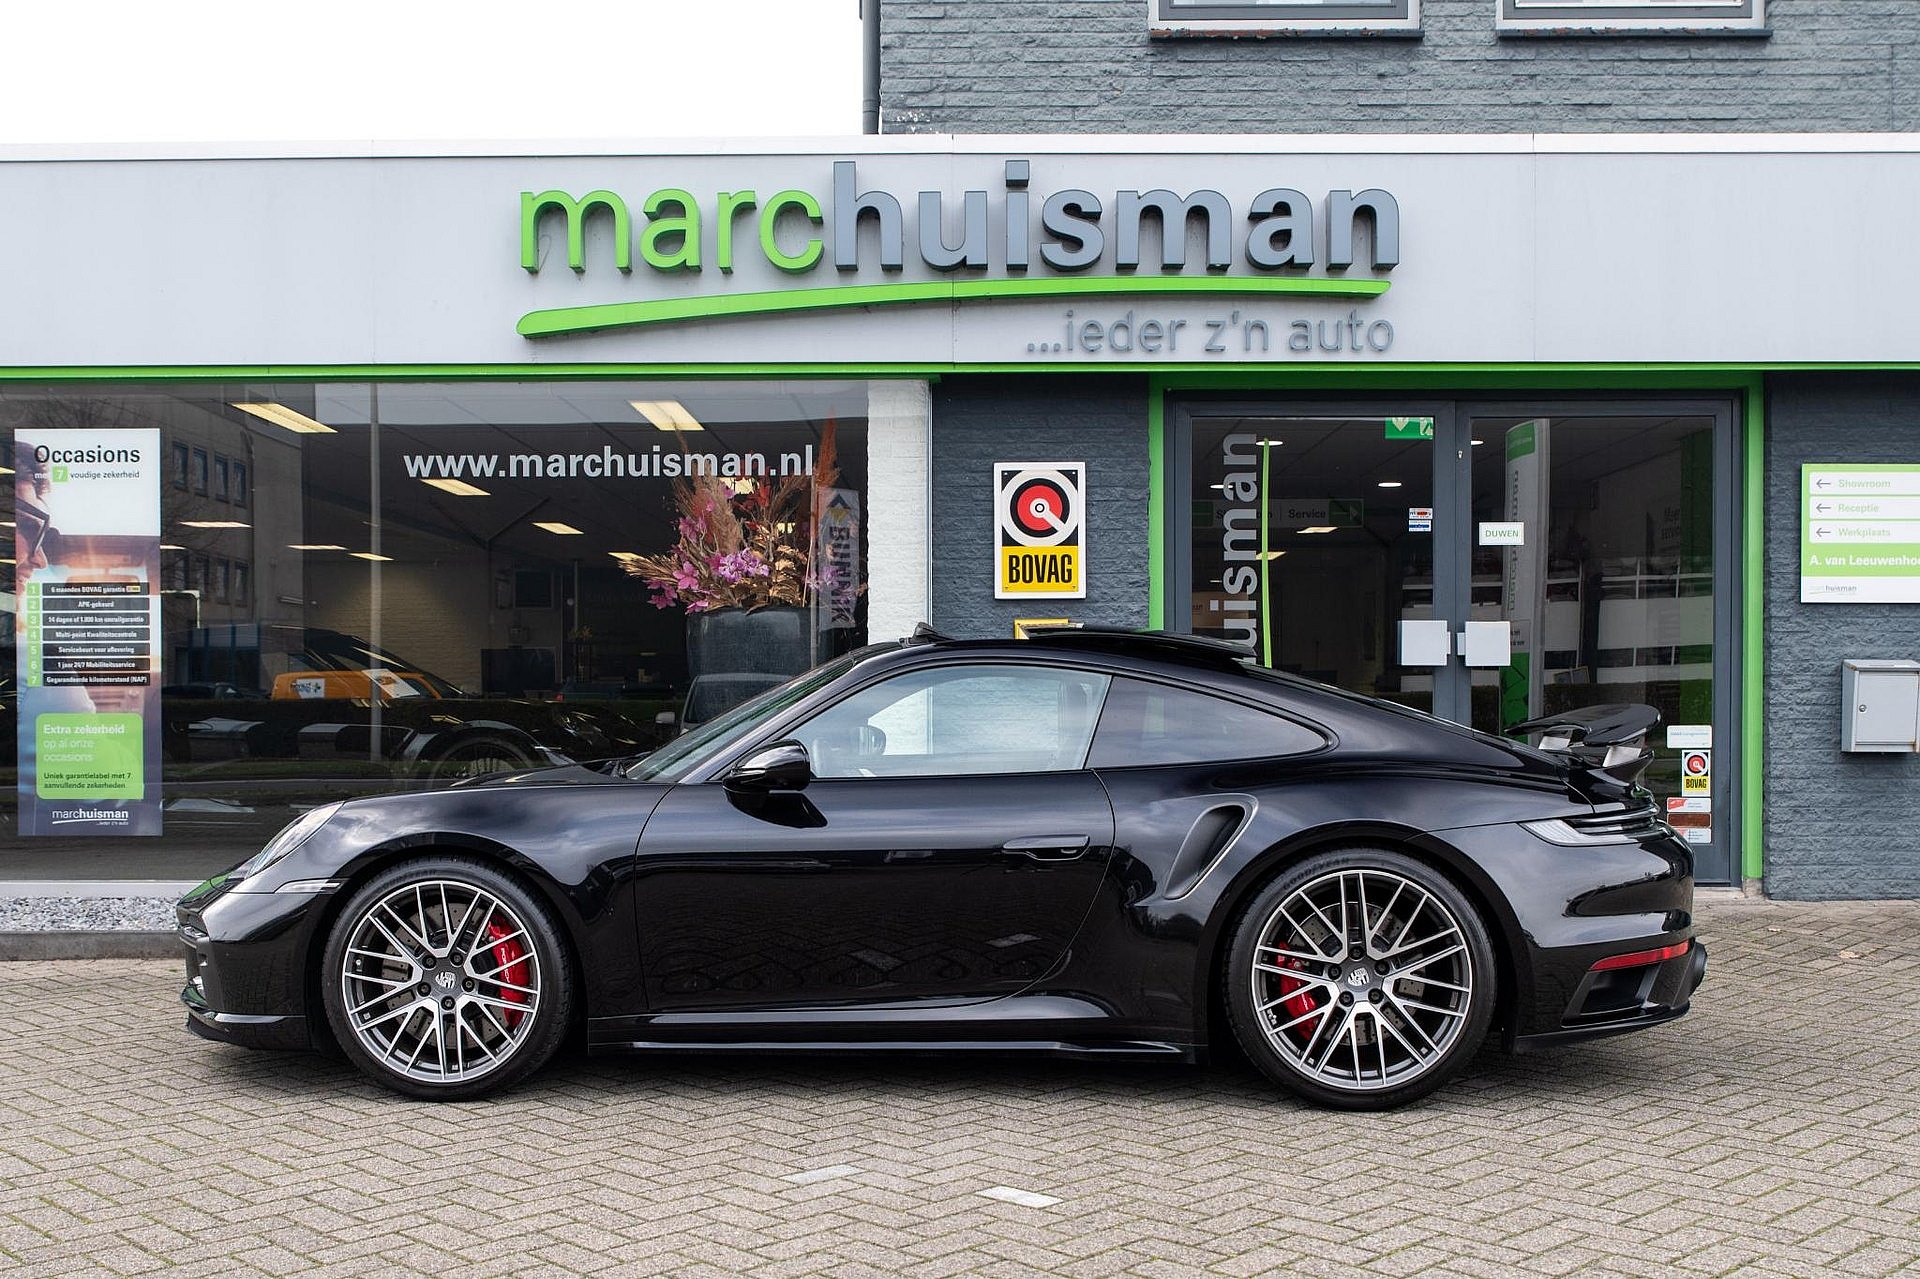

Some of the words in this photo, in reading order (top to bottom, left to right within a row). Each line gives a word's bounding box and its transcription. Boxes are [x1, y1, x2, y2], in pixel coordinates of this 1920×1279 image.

[520, 160, 1400, 273] marchuisman
[1027, 309, 1187, 352] ...ieder
[1205, 311, 1269, 352] z'n
[1288, 309, 1394, 352] auto
[34, 445, 141, 463] Occasions
[403, 445, 812, 478] www.marchuisman.nl
[57, 470, 64, 480] 7
[70, 470, 101, 480] voudige
[103, 470, 140, 478] zekerheid
[1838, 479, 1891, 488] Showroom
[1288, 508, 1326, 518] Service
[1838, 504, 1879, 513] Receptie
[1838, 528, 1890, 537] Werkplaats
[1810, 555, 1822, 565] A.
[1826, 557, 1845, 565] van
[1008, 554, 1072, 584] BOVAG
[43, 724, 71, 734] Extra
[1686, 779, 1706, 788] BOVAG
[52, 808, 128, 819] marchuisman
